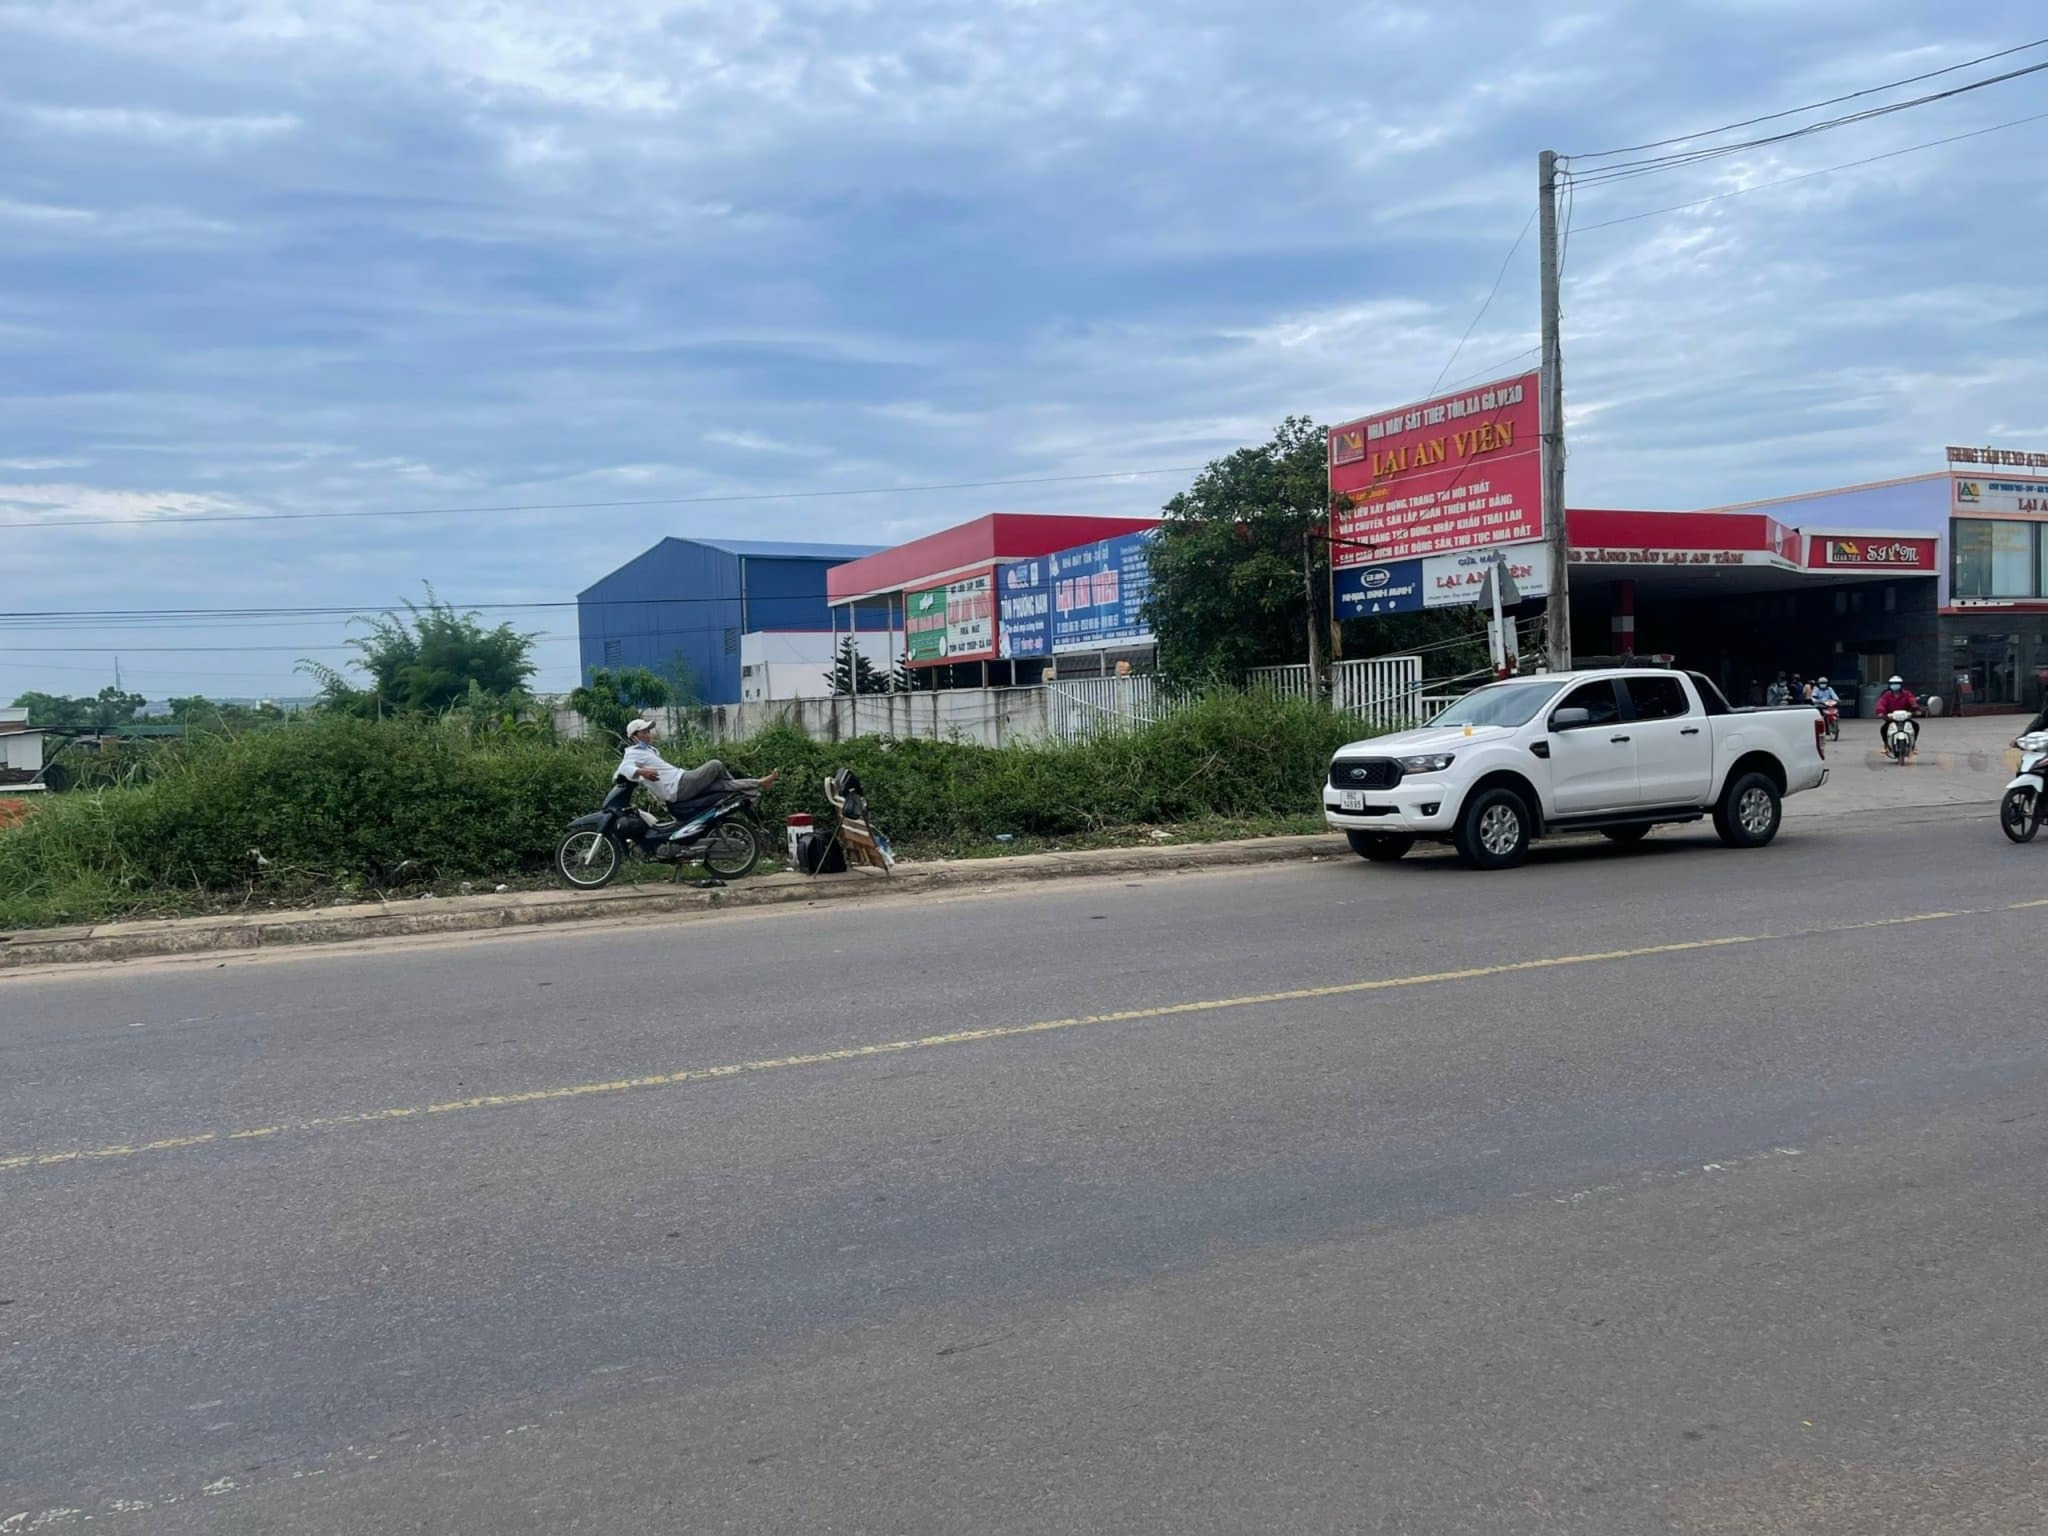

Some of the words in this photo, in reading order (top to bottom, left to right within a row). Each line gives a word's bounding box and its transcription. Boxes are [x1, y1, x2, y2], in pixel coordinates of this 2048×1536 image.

[1372, 446, 1409, 478] LẠI
[1414, 437, 1448, 468] AN
[1453, 421, 1514, 458] VIÊN
[1504, 508, 1522, 523] LAN
[1585, 549, 1629, 563] XĂNG
[1662, 552, 1688, 566] LẠI
[1689, 553, 1711, 564] AN
[1436, 574, 1462, 589] LẠI
